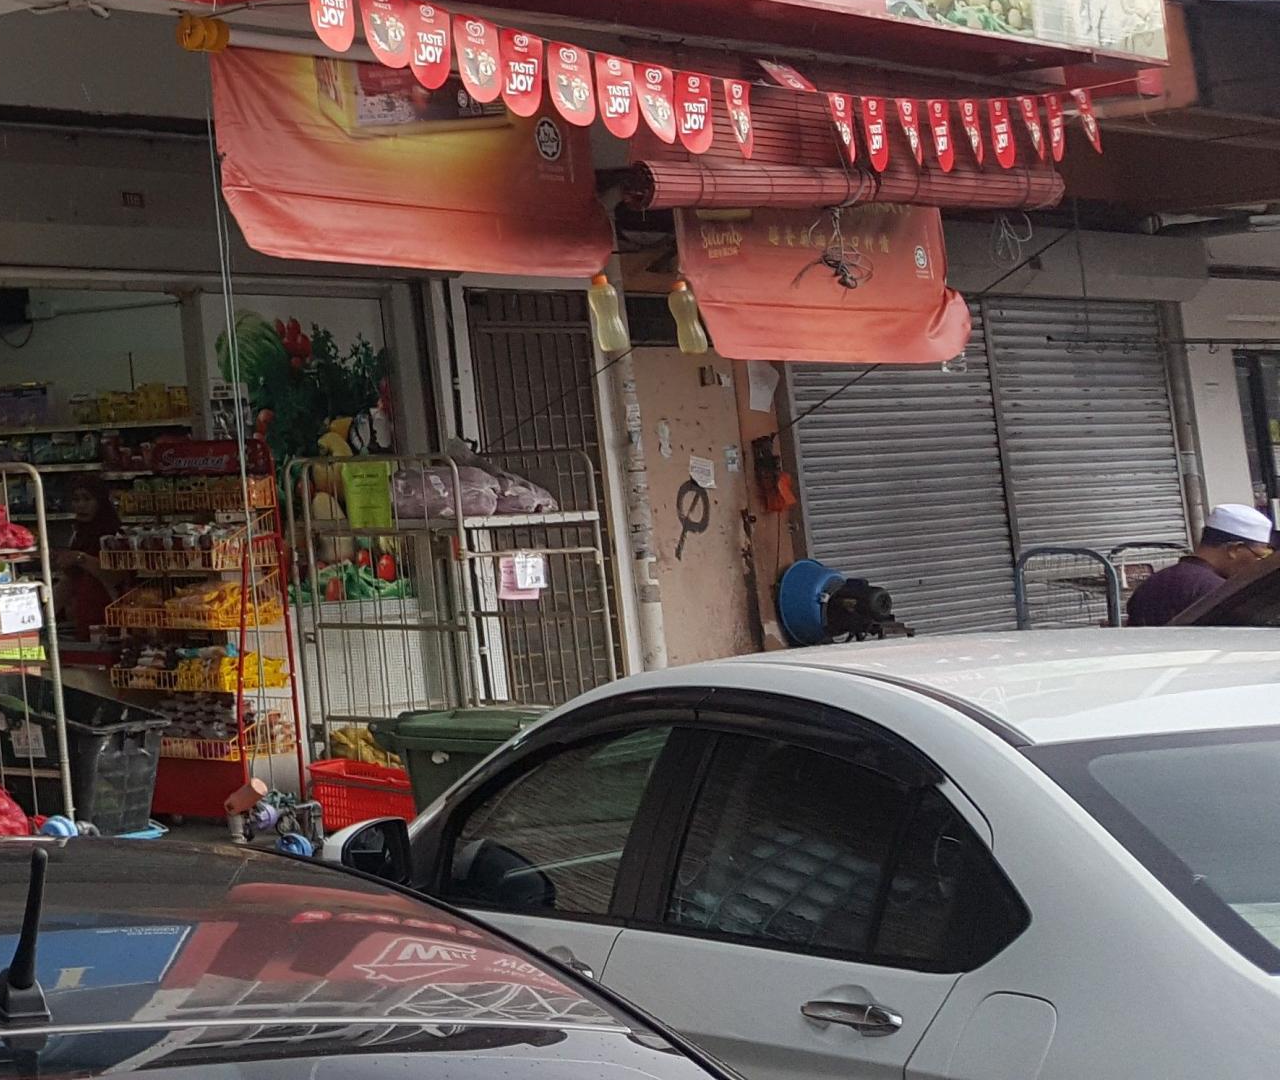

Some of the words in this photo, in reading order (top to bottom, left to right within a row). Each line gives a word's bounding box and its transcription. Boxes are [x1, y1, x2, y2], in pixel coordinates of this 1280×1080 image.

[320, 7, 345, 26] JOY
[417, 32, 443, 46] TASTE
[418, 44, 442, 63] JOY
[509, 61, 534, 73] TASTE
[510, 73, 534, 92] JOY
[607, 85, 630, 97] TASTE
[608, 96, 630, 114] JOY
[683, 101, 705, 112] TASTE
[684, 111, 705, 130] JOY
